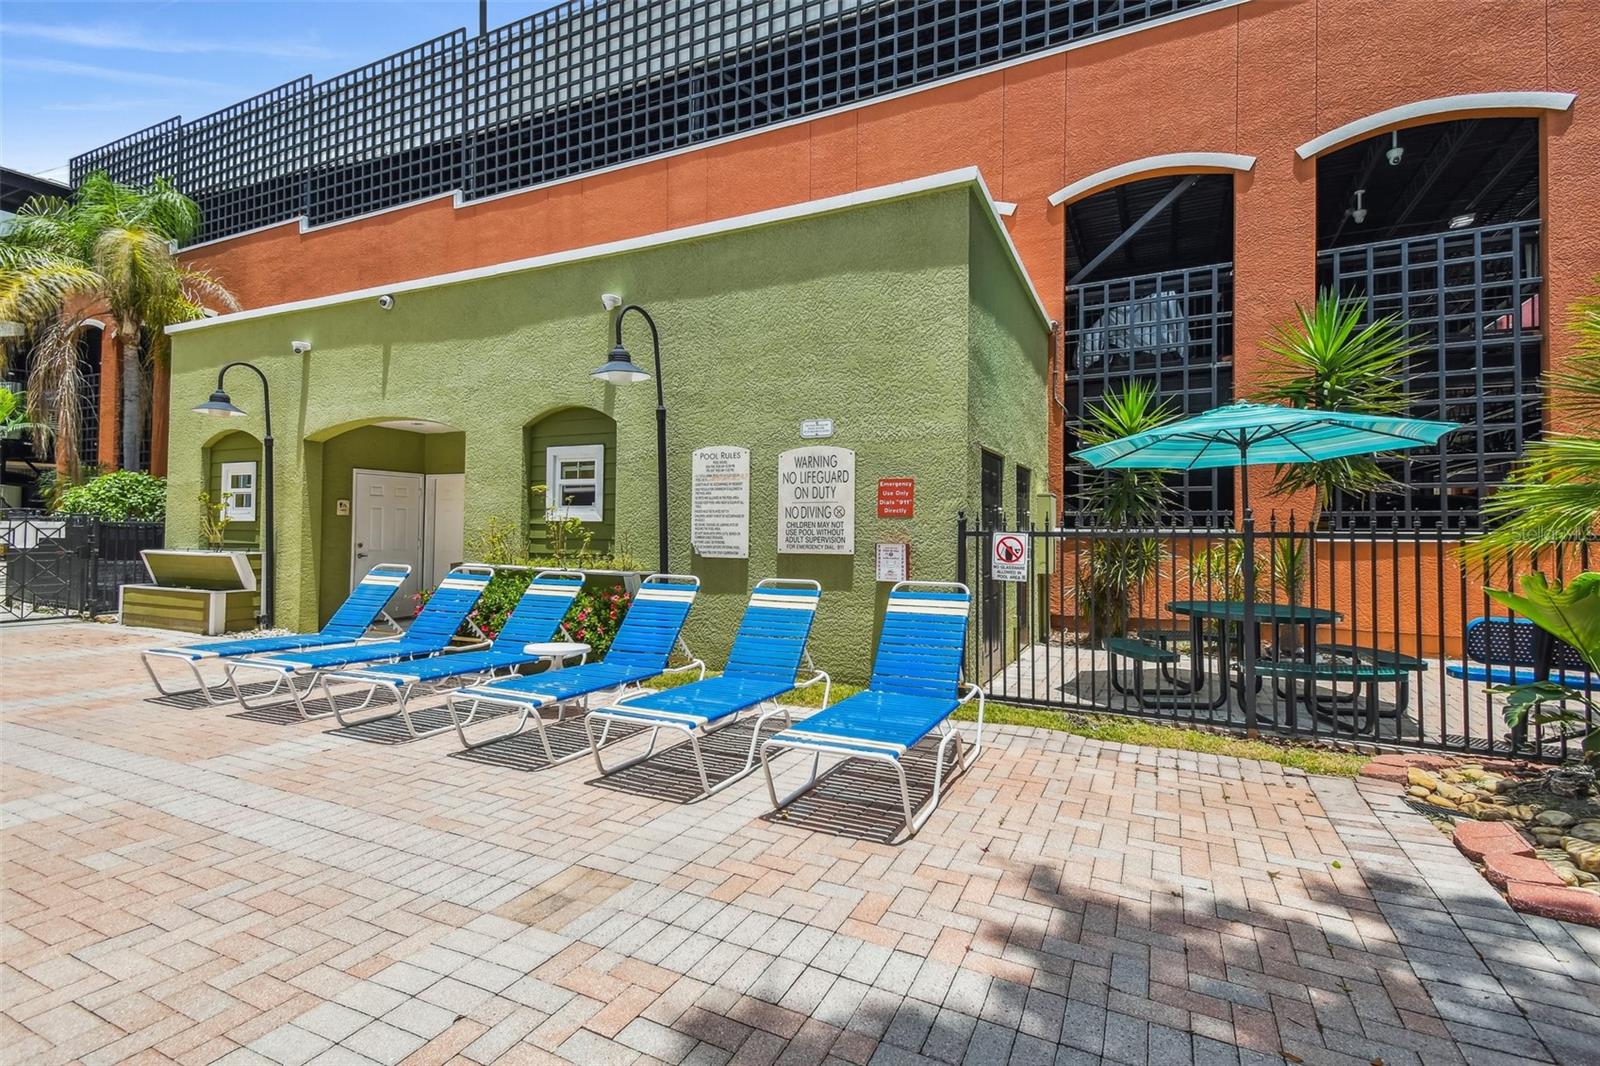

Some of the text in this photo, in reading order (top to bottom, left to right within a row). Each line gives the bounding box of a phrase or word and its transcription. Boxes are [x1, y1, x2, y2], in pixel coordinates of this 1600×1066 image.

[700, 451, 741, 460] POOL RULES
[794, 454, 838, 468] WARNING
[782, 470, 850, 485] NO LIFEGUARD
[794, 486, 837, 500] ON DUTY
[785, 505, 832, 519] NO DIVING
[786, 521, 844, 529] CHILDREN MAY NOT
[785, 536, 846, 544] ADULT SUPERVISION
